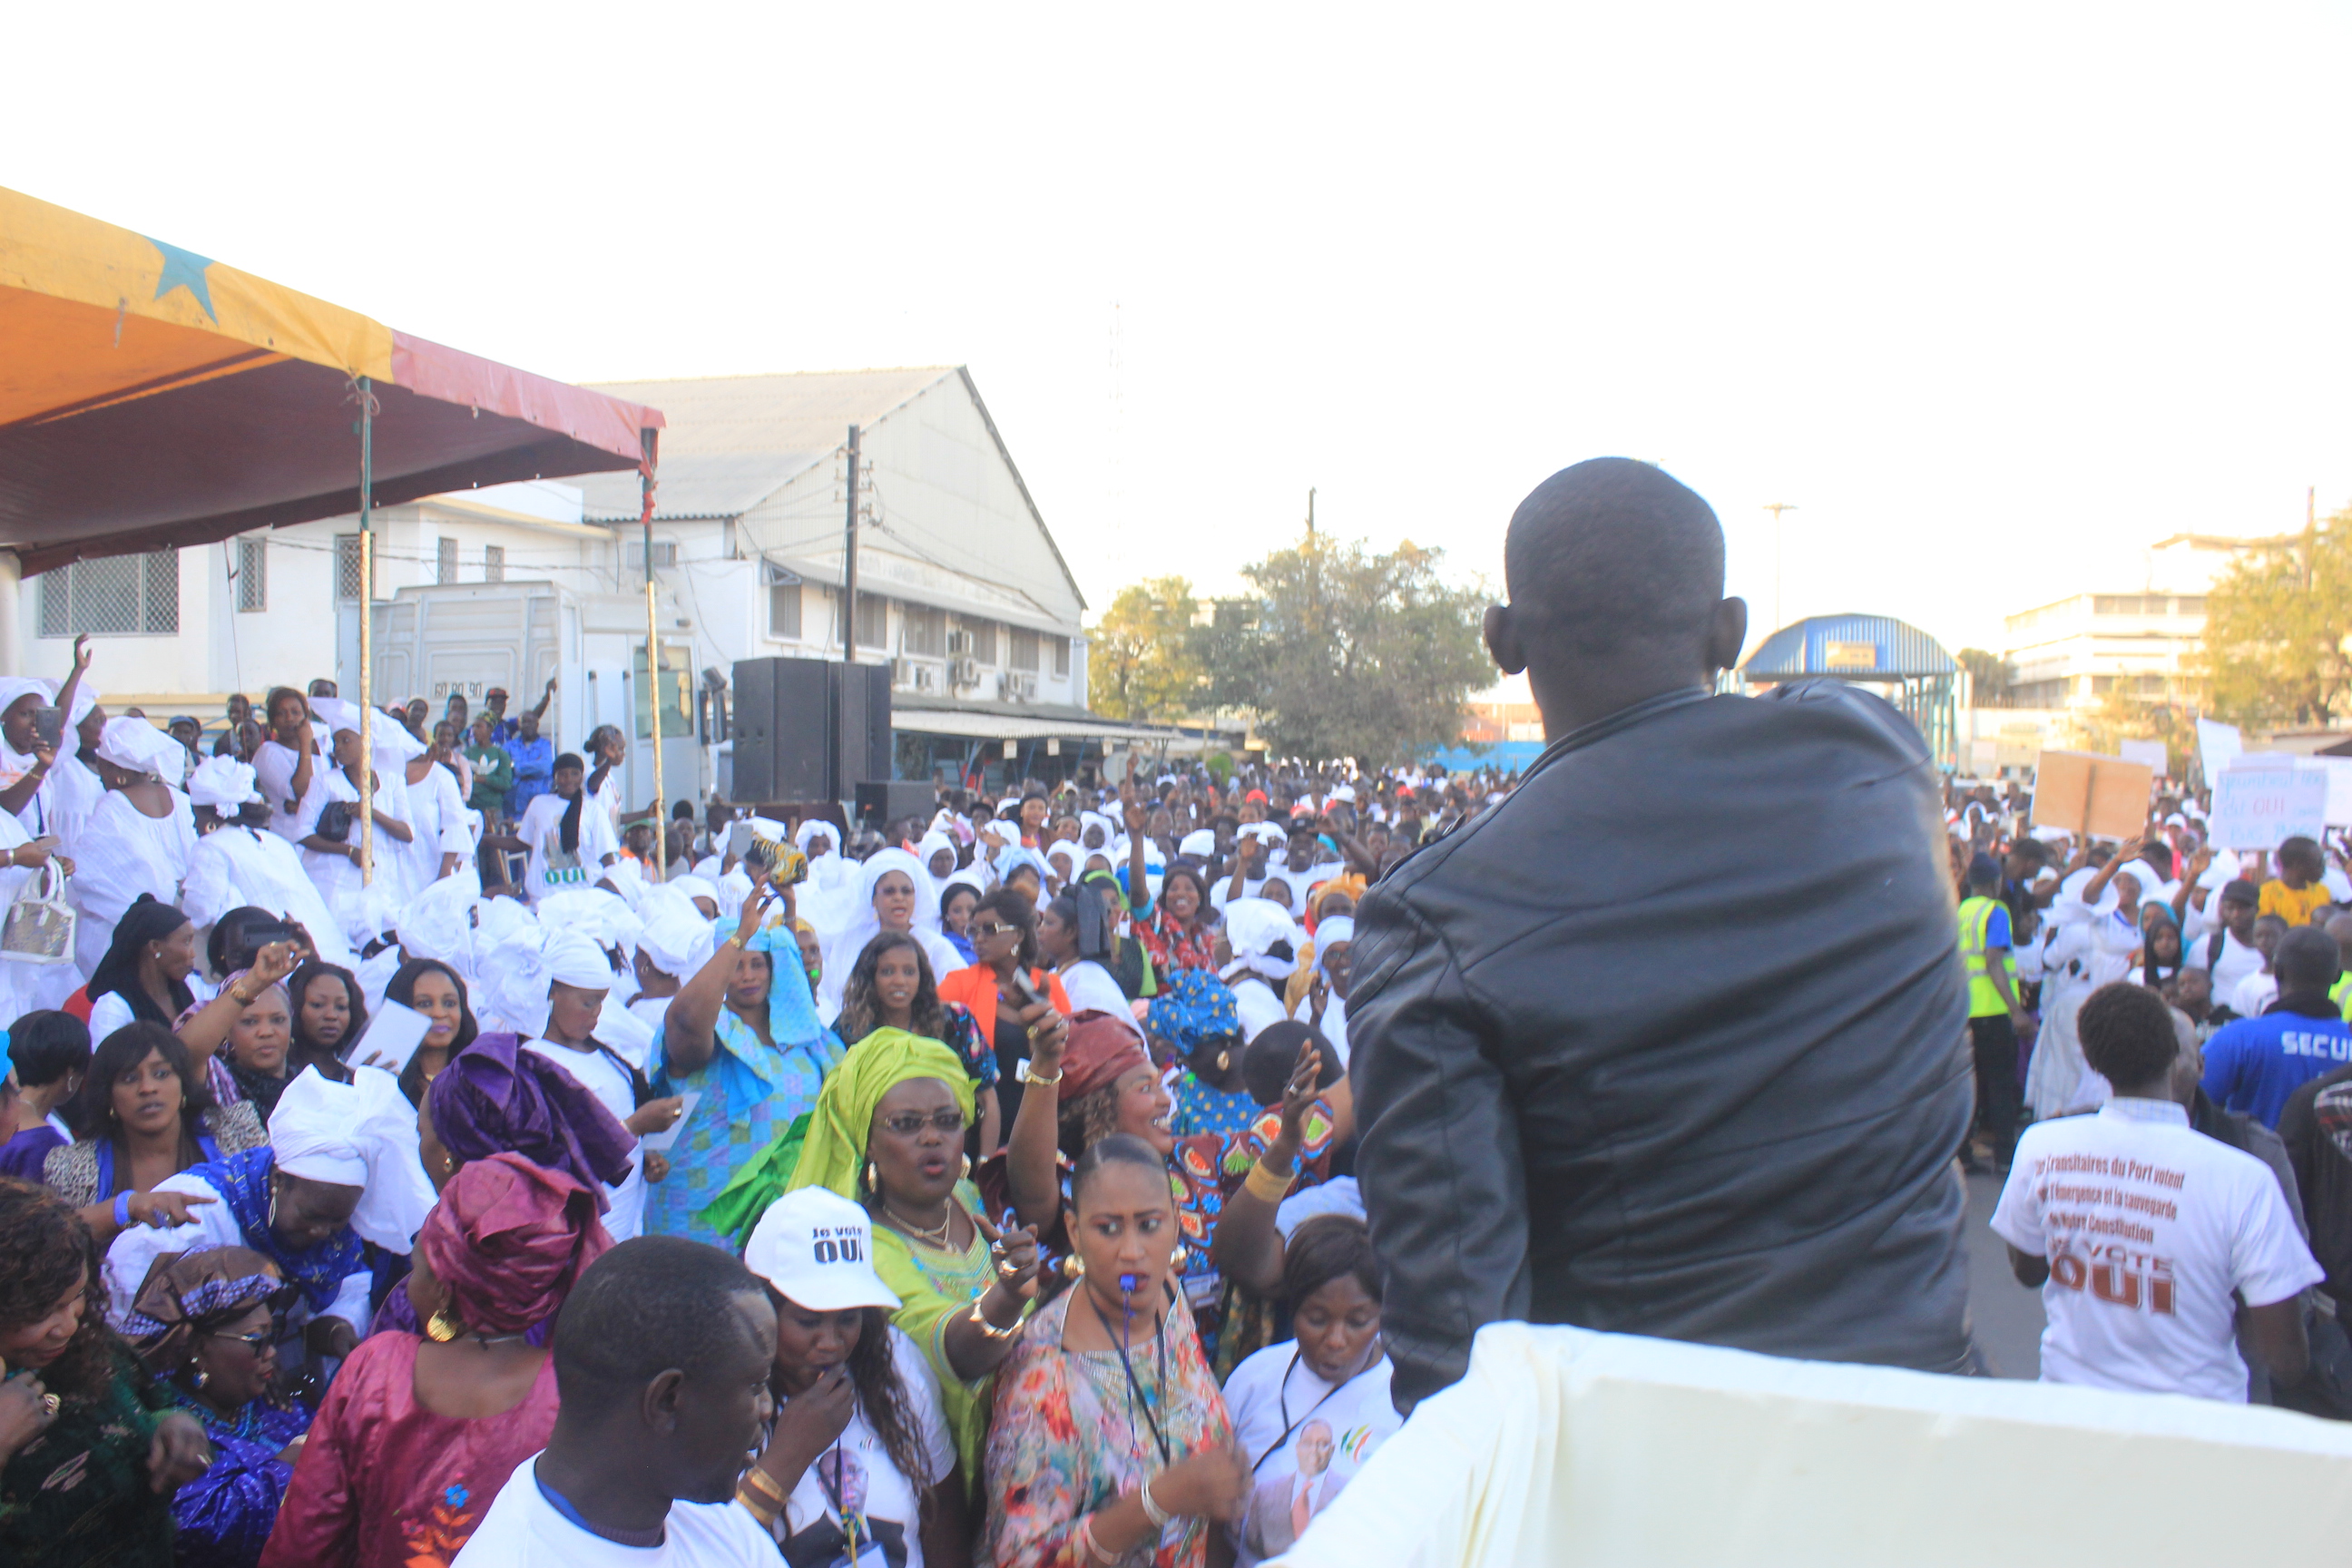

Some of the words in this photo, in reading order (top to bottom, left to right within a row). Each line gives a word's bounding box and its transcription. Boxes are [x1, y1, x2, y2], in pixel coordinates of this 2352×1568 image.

[545, 867, 586, 885] OUI
[2281, 1031, 2352, 1062] SECU
[2111, 1157, 2125, 1178] du
[2128, 1160, 2153, 1181] Port
[2154, 1169, 2185, 1191] votent
[2103, 1186, 2112, 1205] et
[2113, 1187, 2122, 1206] la
[2123, 1192, 2178, 1220] sauvegarde
[2088, 1213, 2153, 1243] Constitution
[814, 1240, 863, 1262] OUI
[2082, 1240, 2174, 1270] VOTE
[2051, 1253, 2176, 1317] OUI
